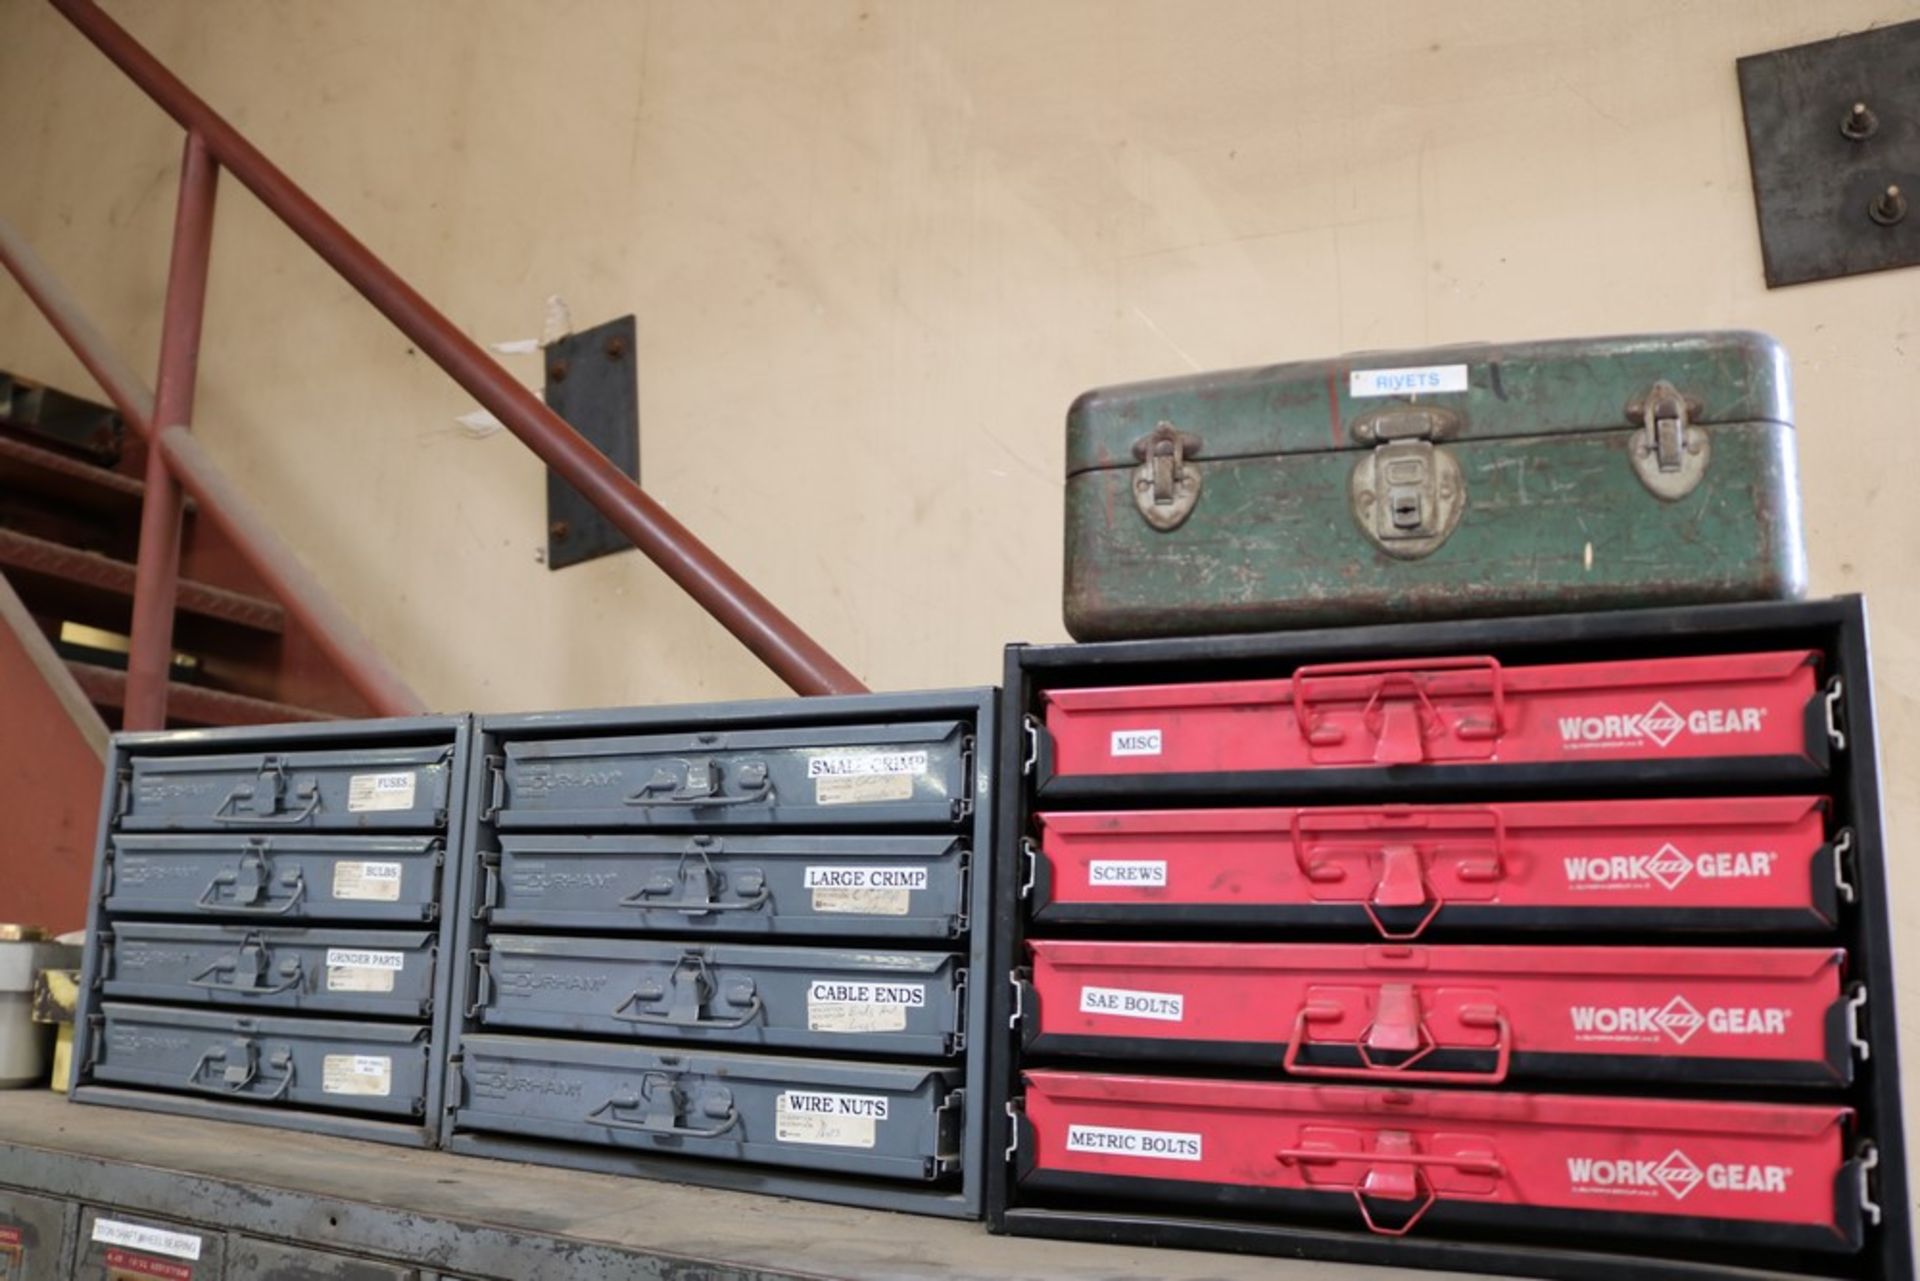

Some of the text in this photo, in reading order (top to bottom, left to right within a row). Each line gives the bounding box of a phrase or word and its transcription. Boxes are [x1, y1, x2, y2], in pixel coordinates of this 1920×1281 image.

[1375, 371, 1441, 391] RIVETS
[1558, 713, 1645, 740] WORK
[1116, 735, 1159, 750] MISC
[811, 758, 868, 775] SMAL
[810, 870, 926, 887] LARGE CRIMP
[1093, 865, 1163, 881] SCREWS
[1564, 855, 1651, 881] WORK
[372, 953, 403, 967] PARTS
[813, 984, 924, 1004] CABLE ENDS
[1085, 992, 1181, 1015] SAE BOLTS
[1570, 1006, 1660, 1033] WORK
[789, 1094, 886, 1117] WIRE NUTS
[1071, 1131, 1199, 1155] METRIC BOLTS
[1567, 1157, 1658, 1185] WORK
